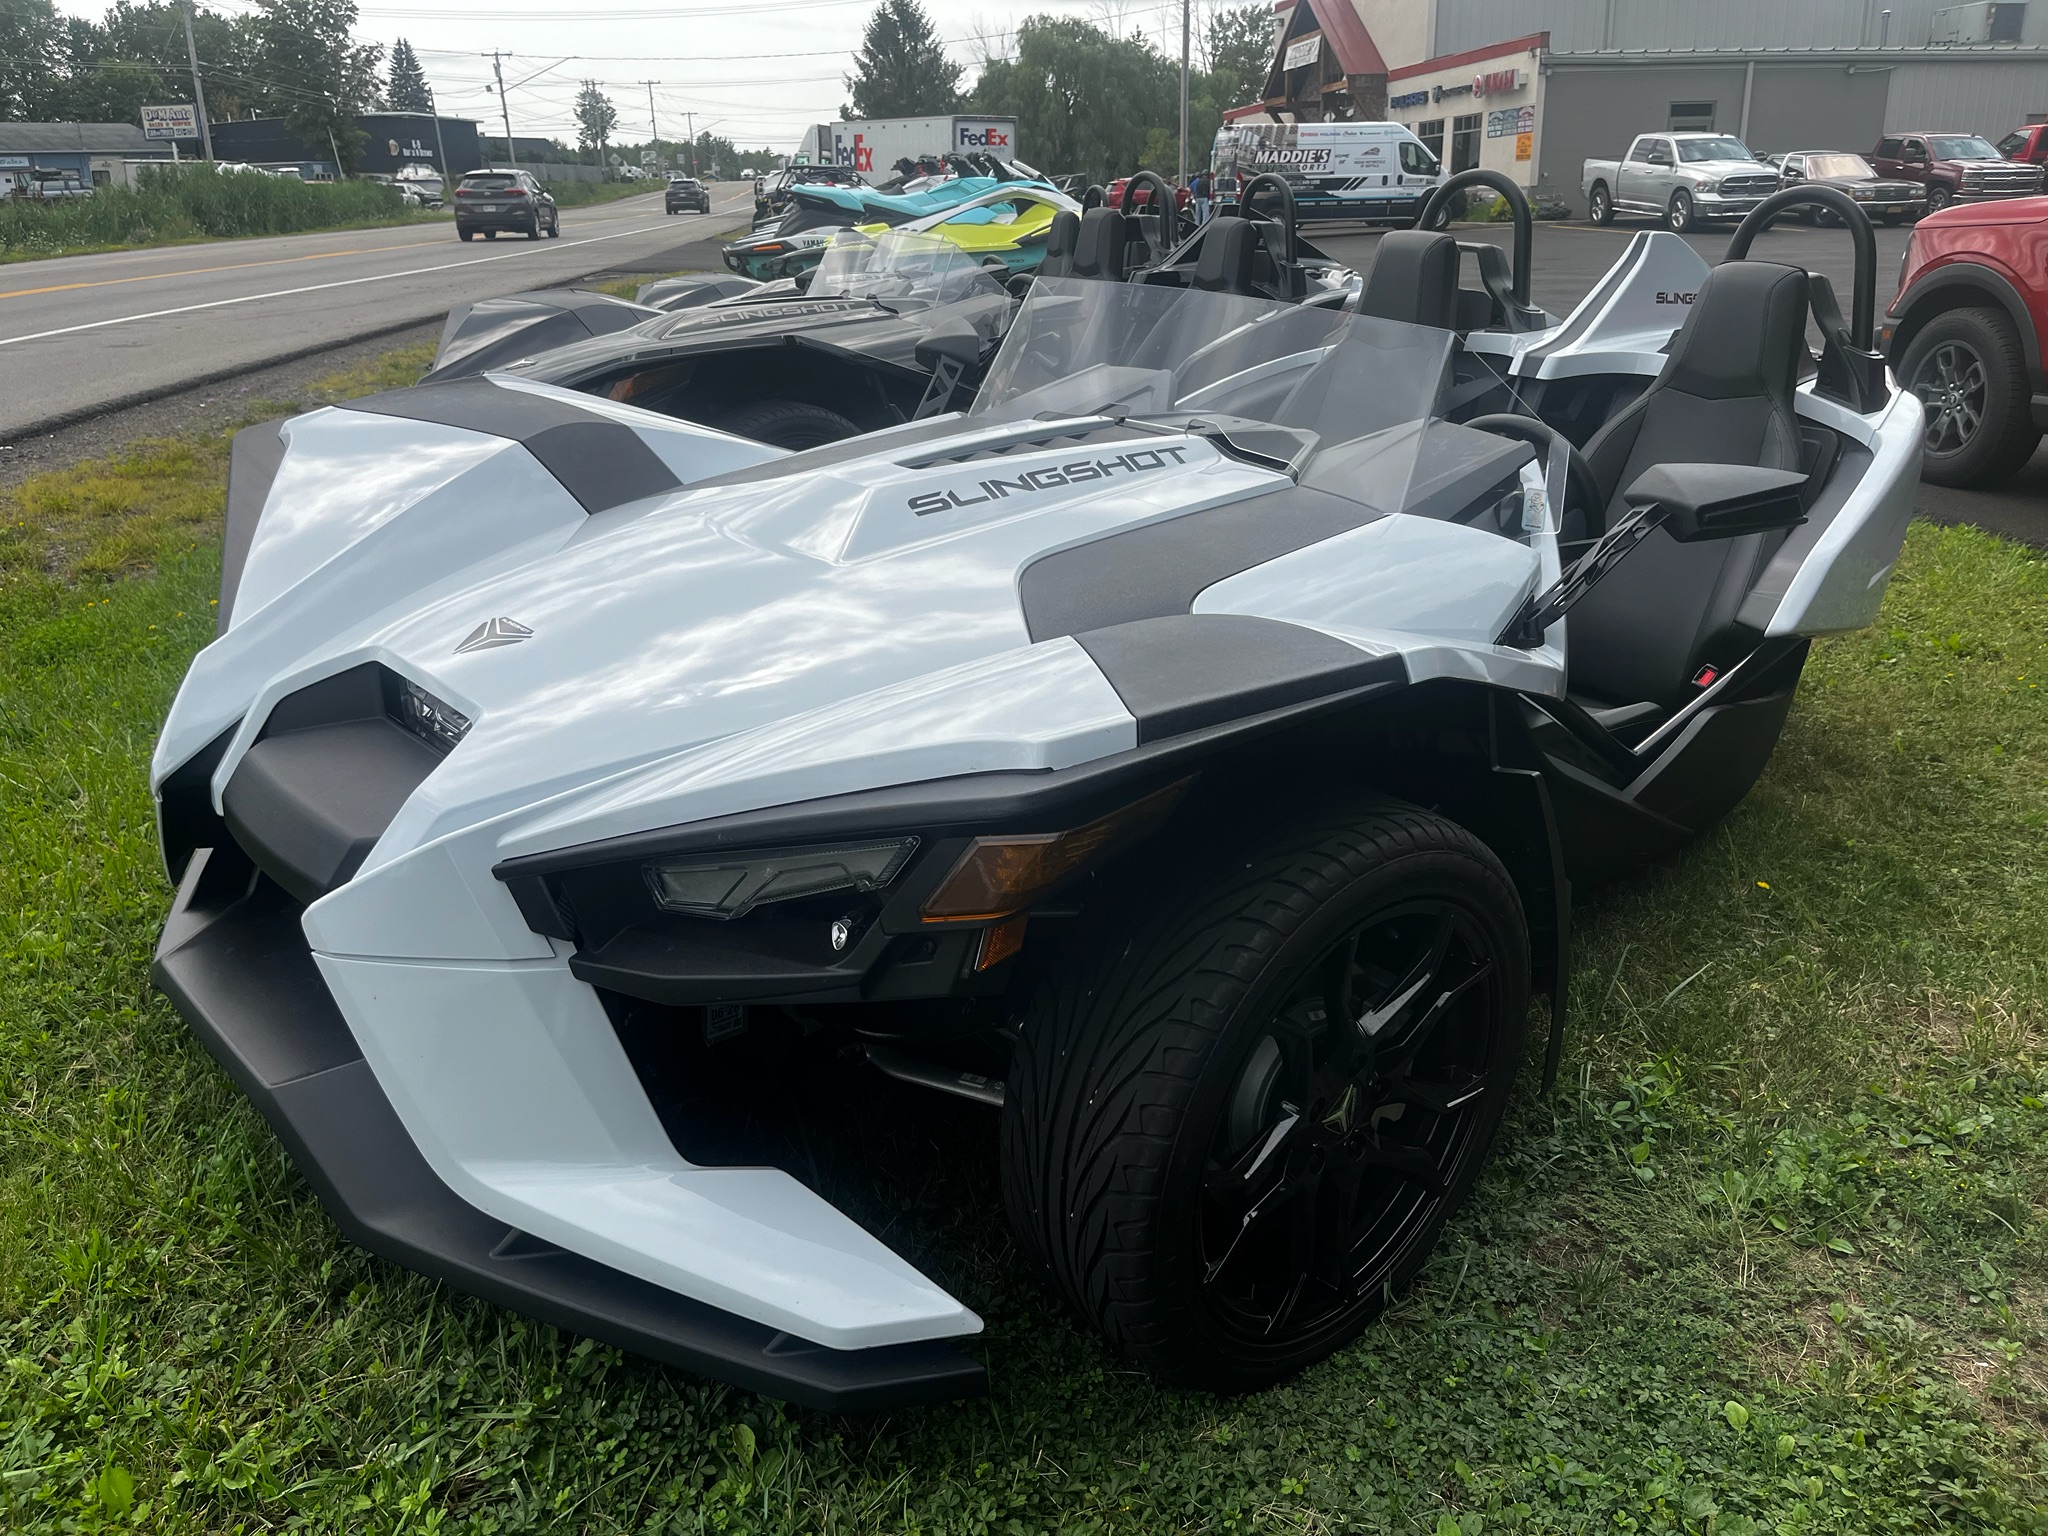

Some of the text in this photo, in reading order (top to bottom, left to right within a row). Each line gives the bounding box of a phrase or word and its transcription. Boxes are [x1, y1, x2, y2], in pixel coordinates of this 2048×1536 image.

[169, 109, 193, 121] Auto
[960, 128, 1008, 146] FedEx
[835, 134, 873, 172] FedEx
[1254, 150, 1330, 164] MADDIE'S
[1251, 163, 1327, 172] MOTORSPORTS
[701, 302, 856, 325] SLINGSHOT
[907, 446, 1188, 517] SLINGSHOT
